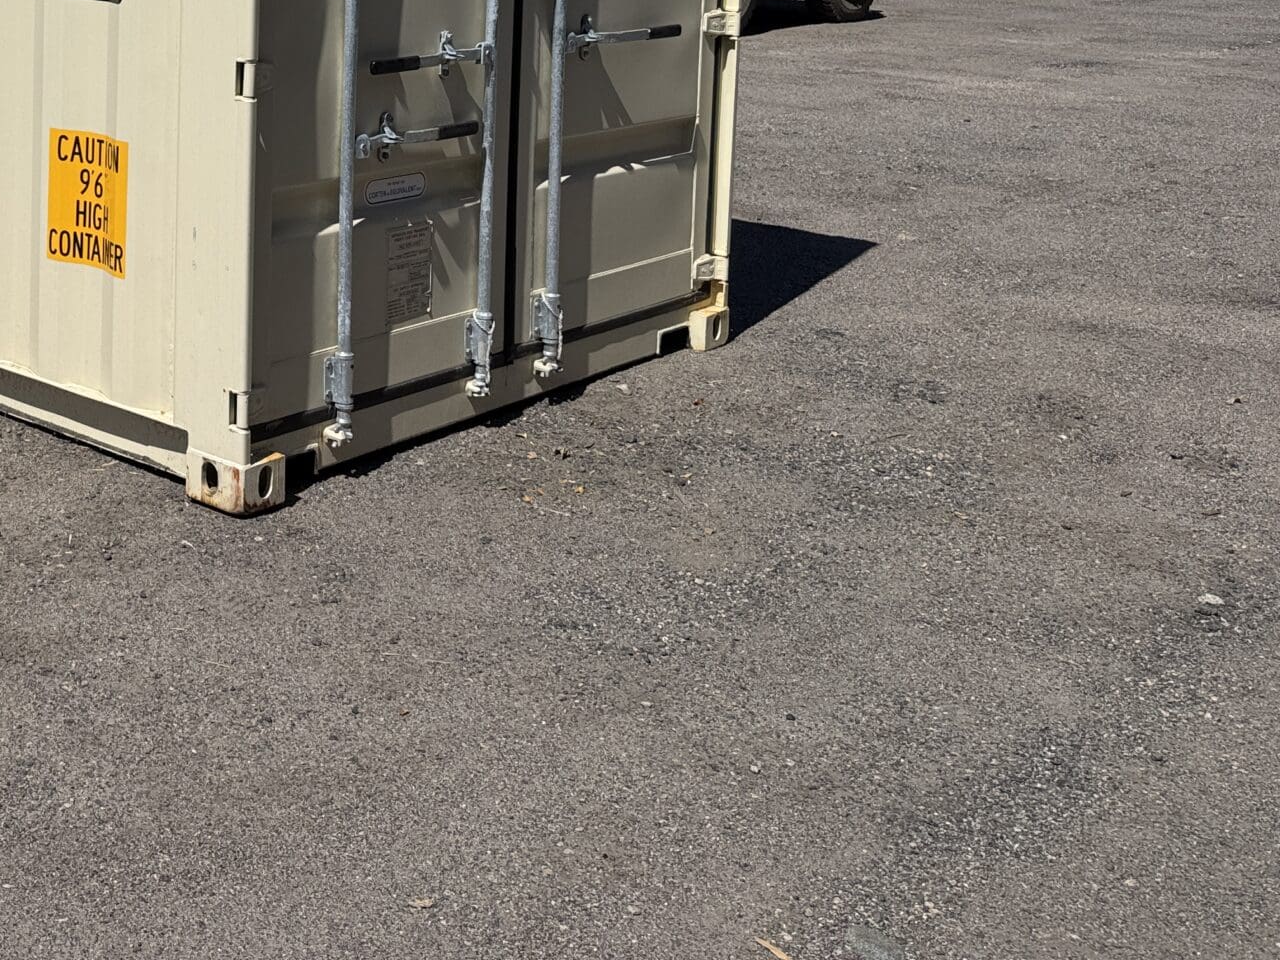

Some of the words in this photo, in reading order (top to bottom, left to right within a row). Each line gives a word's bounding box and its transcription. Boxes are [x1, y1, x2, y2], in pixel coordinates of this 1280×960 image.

[57, 134, 119, 173] CAUTION
[75, 199, 108, 234] HIGH
[48, 228, 123, 273] CONTAINER
